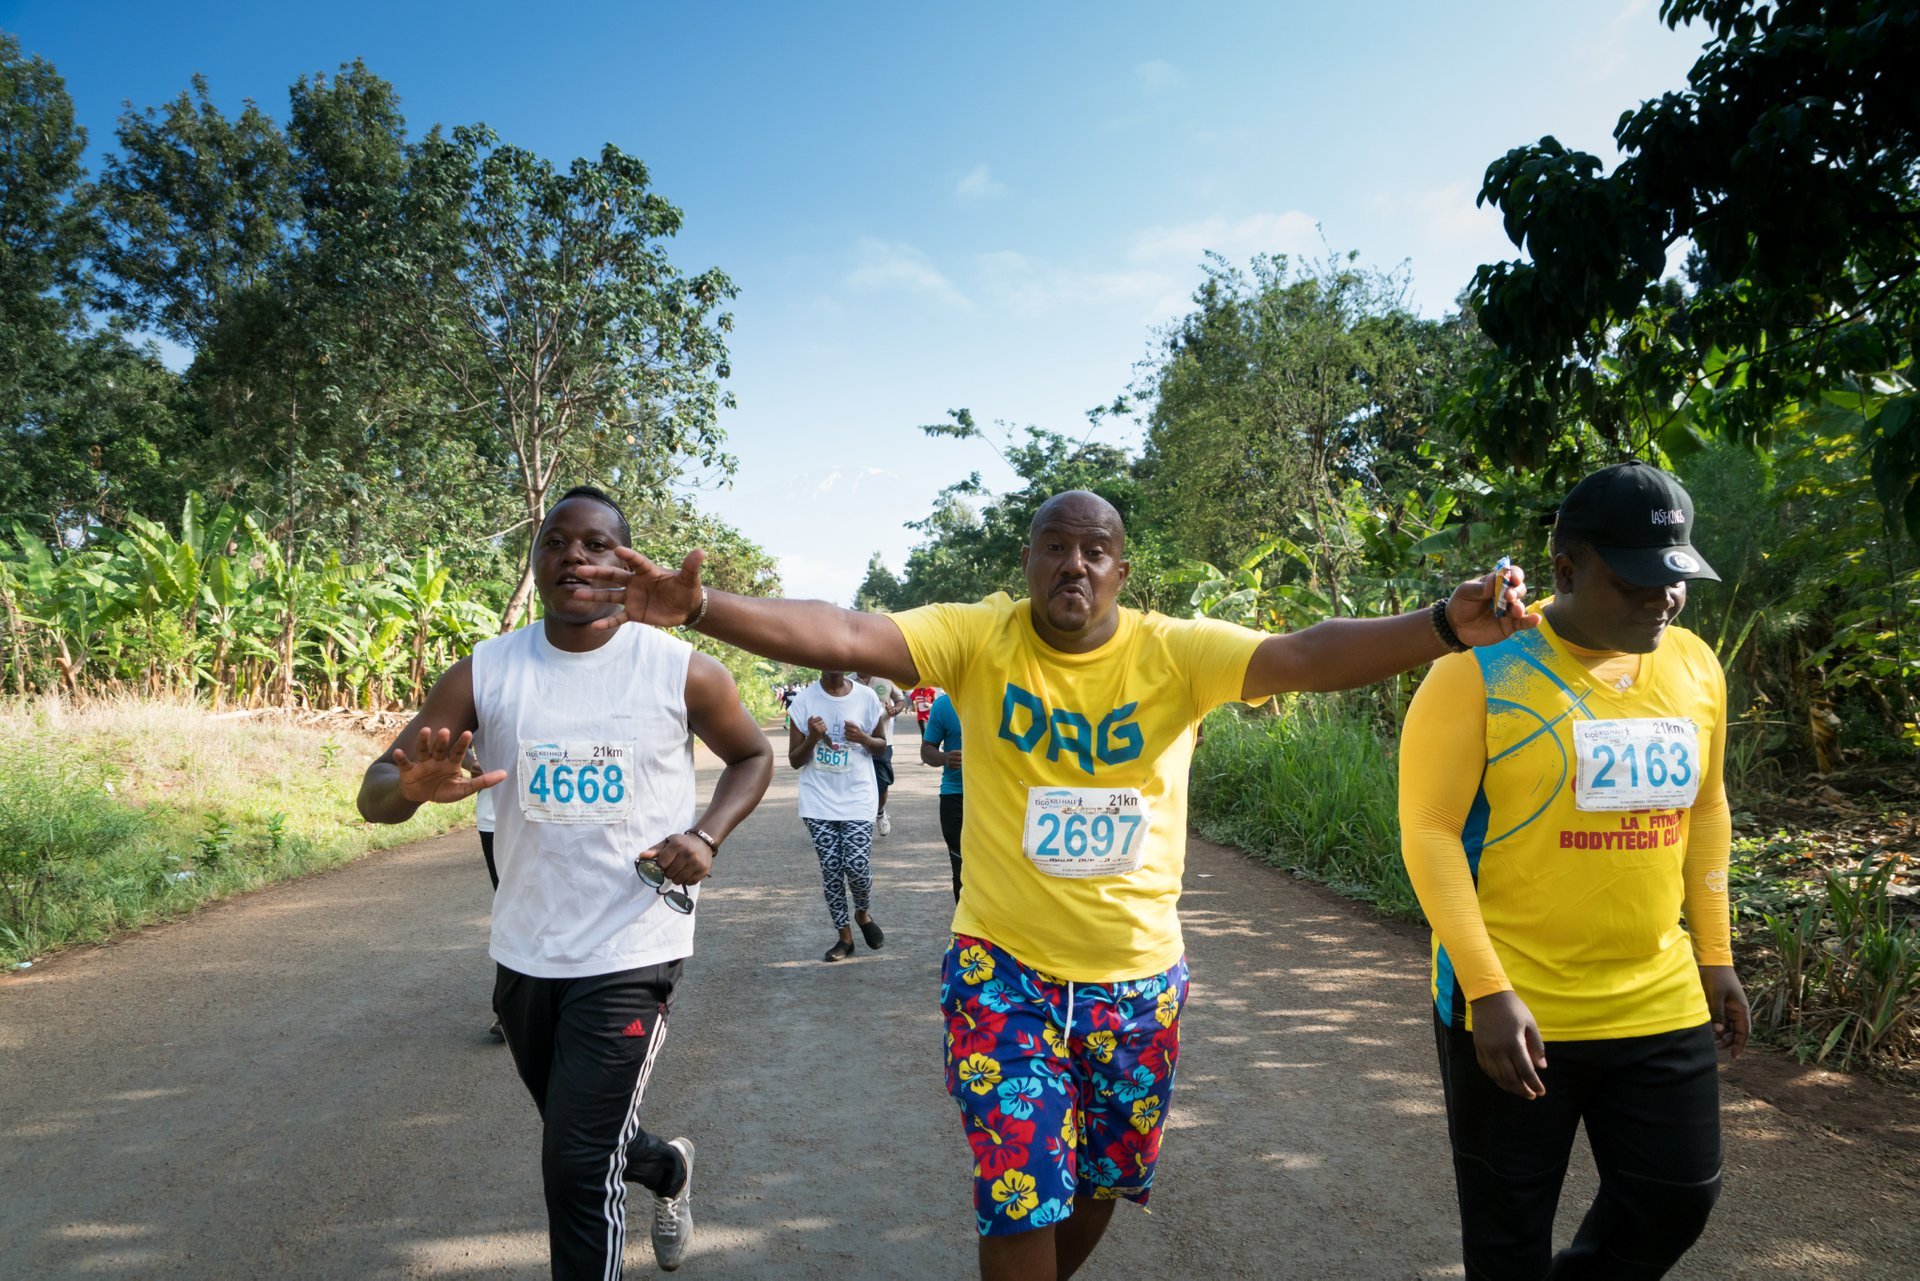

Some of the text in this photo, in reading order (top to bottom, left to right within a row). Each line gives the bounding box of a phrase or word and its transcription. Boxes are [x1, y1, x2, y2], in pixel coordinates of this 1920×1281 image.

[998, 682, 1144, 776] DAG
[1653, 722, 1684, 734] 21km
[593, 746, 623, 758] 21km
[816, 747, 849, 766] 5661
[1591, 742, 1691, 788] 2163
[529, 764, 625, 804] 4668
[1035, 813, 1142, 857] 2697
[1621, 817, 1640, 830] LA
[1560, 825, 1681, 850] BODYTECH CLU
